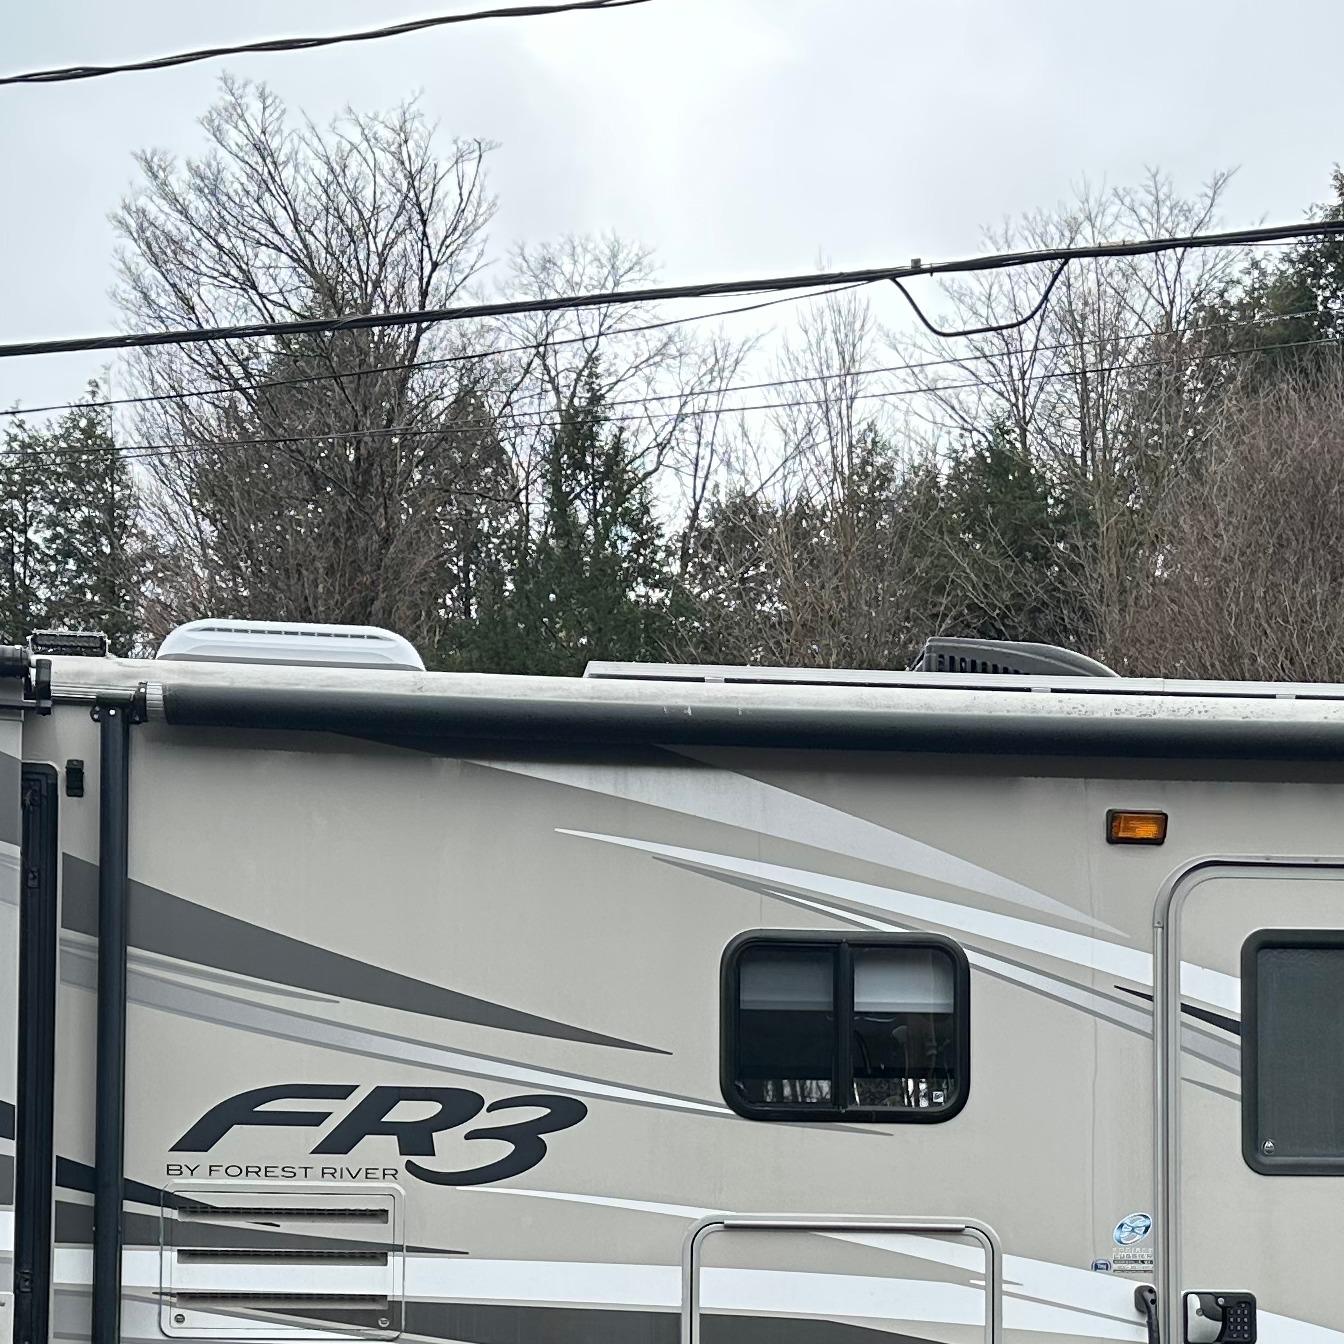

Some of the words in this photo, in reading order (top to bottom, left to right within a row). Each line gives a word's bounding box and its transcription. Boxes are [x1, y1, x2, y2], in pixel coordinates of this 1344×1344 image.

[167, 1083, 588, 1186] FR3
[166, 1163, 200, 1177] BY
[208, 1164, 314, 1179] FOREST
[321, 1166, 399, 1181] RIVER
